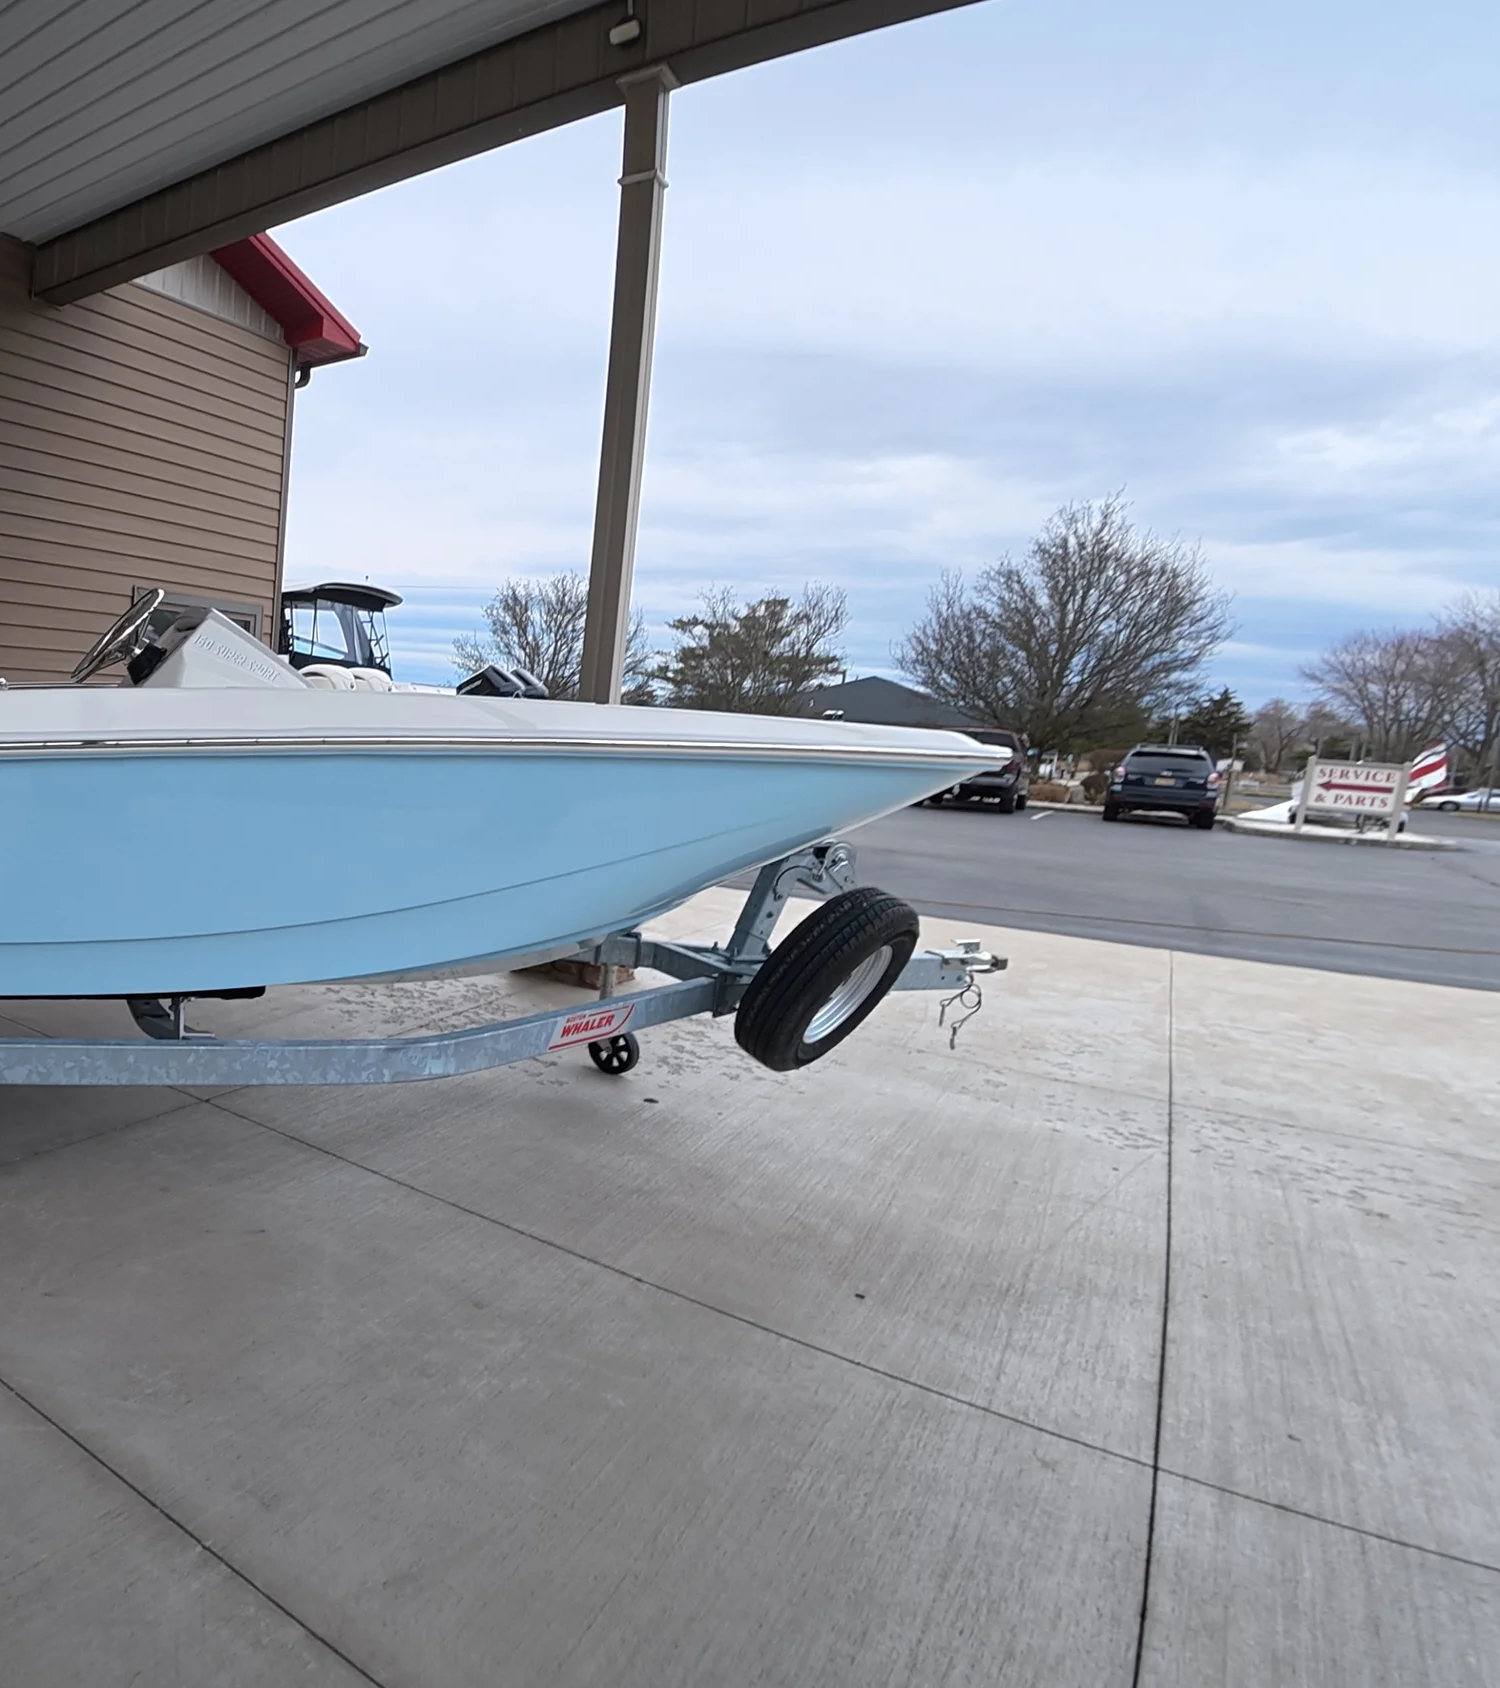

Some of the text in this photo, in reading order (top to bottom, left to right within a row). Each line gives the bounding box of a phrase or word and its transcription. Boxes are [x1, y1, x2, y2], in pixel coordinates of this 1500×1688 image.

[215, 643, 247, 666] SUPER
[247, 660, 280, 682] SPORT
[1318, 768, 1396, 784] SERVICE
[1314, 793, 1389, 808] & PARTS
[560, 1014, 615, 1038] WHALER
